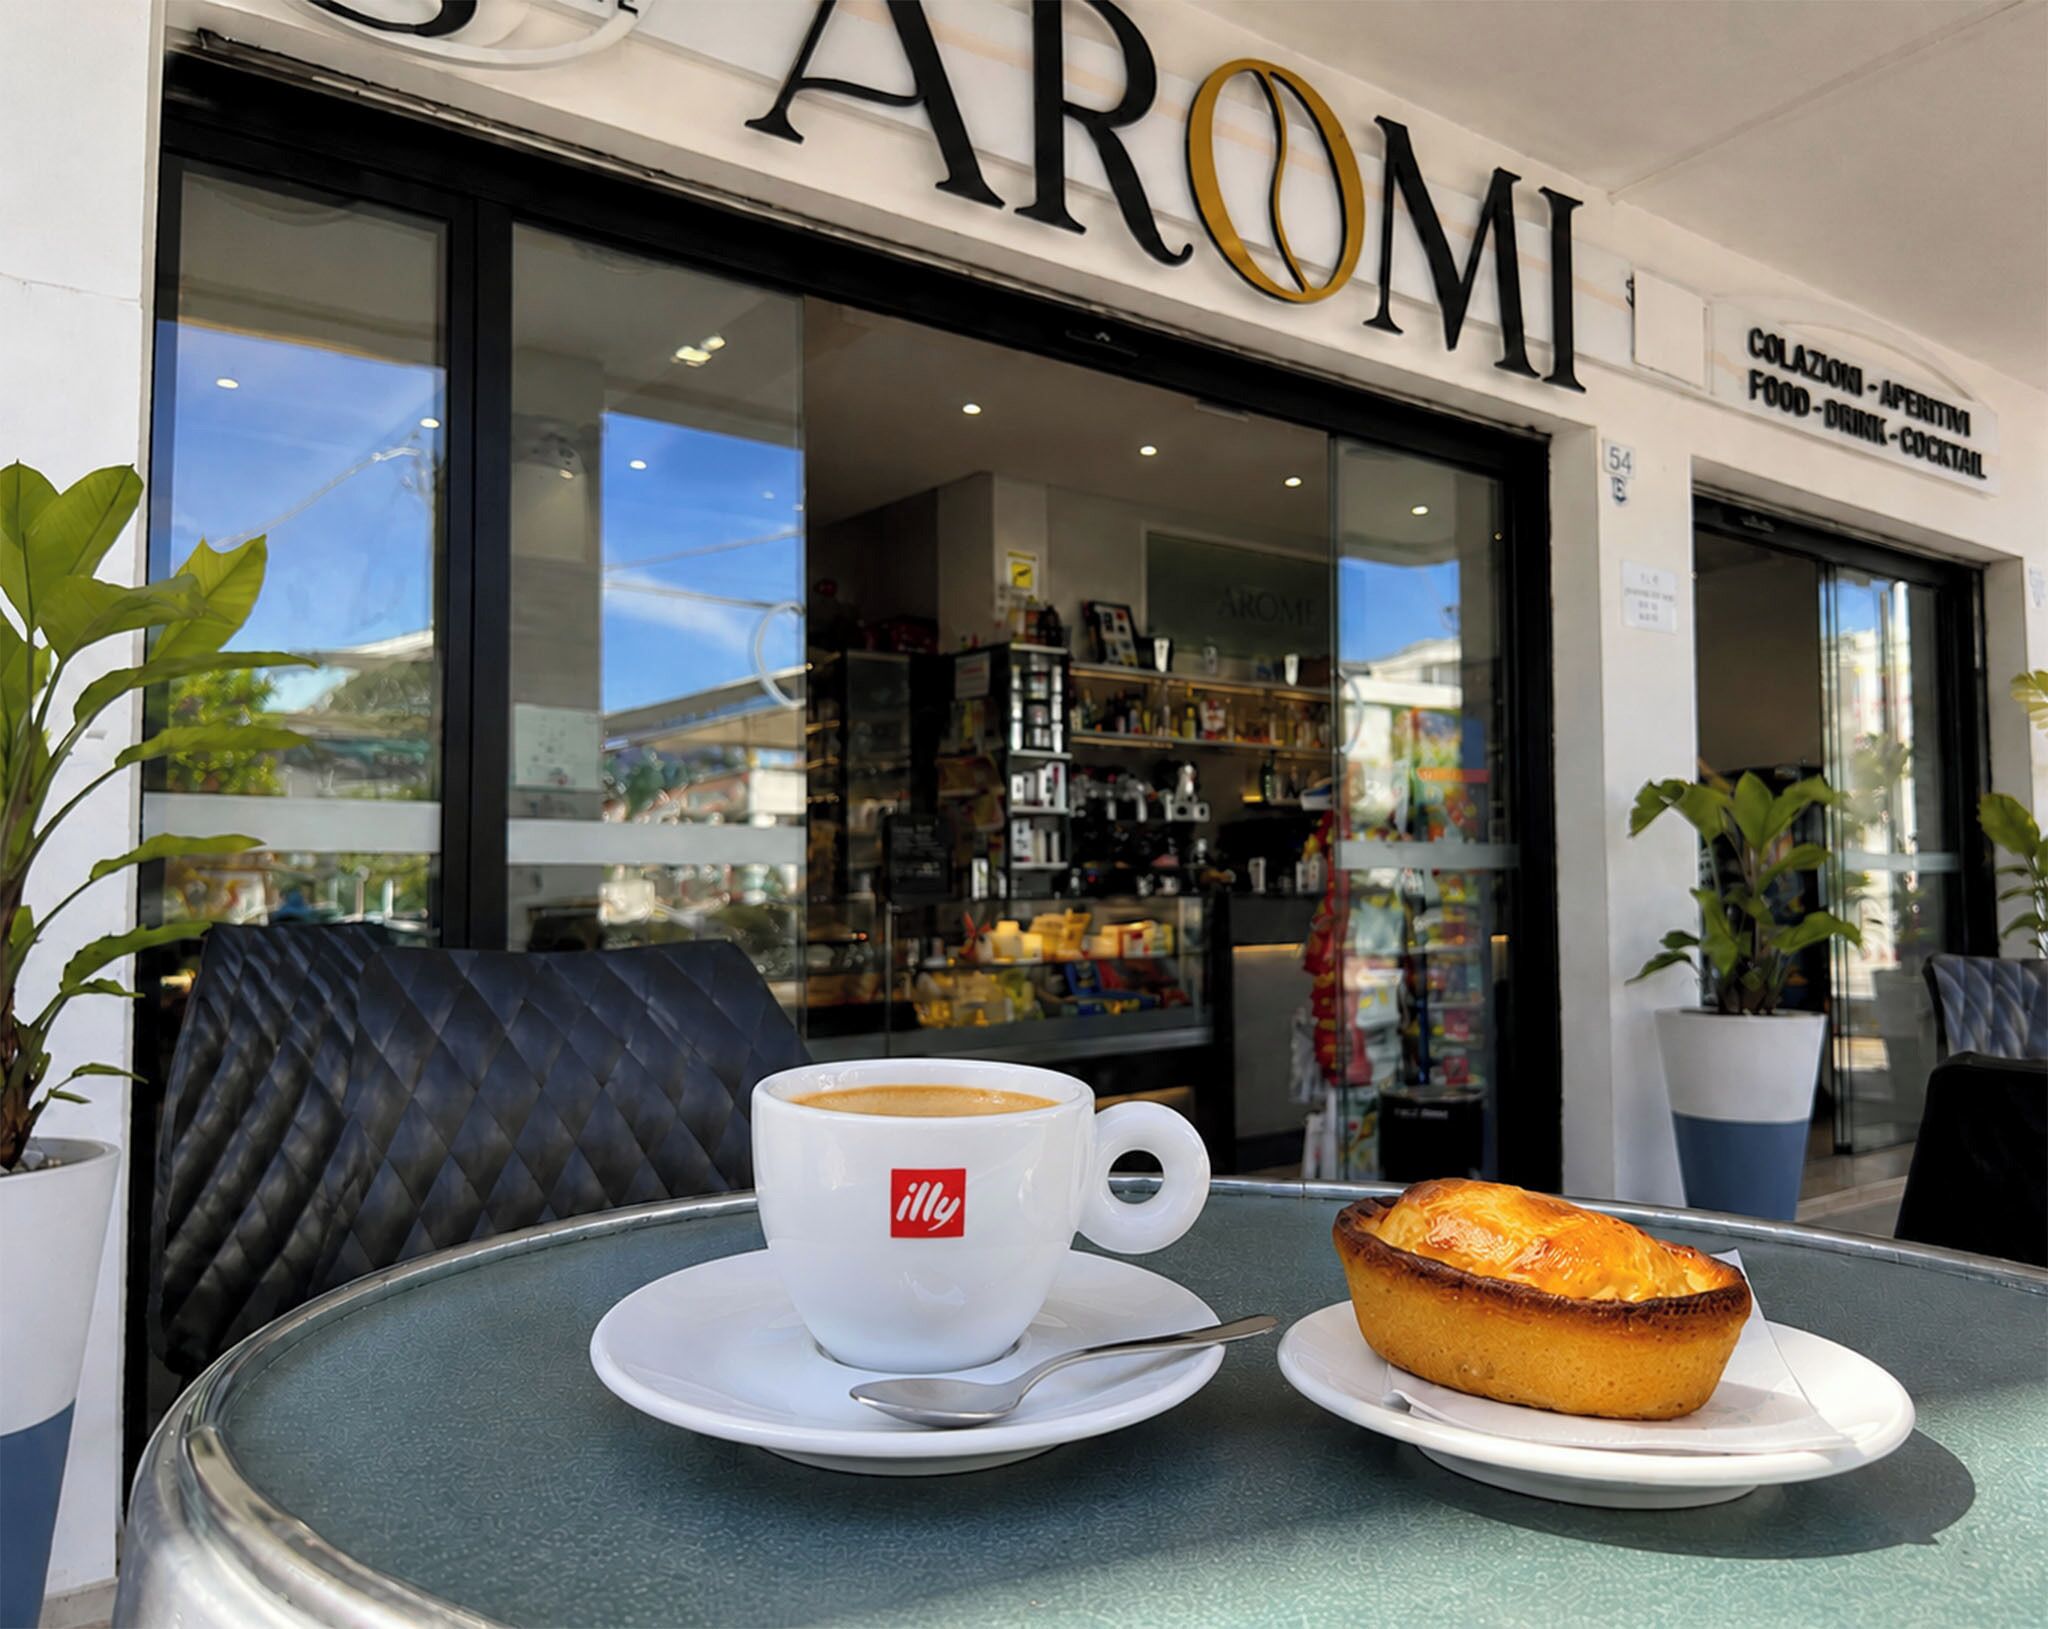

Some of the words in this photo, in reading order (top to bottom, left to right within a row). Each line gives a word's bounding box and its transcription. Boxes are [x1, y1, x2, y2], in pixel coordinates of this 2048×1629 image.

[746, 0, 1587, 394] AROMI
[1748, 328, 1863, 397] COLAZIONI
[1879, 379, 1971, 438] APERITIVI
[1748, 369, 1811, 417] FOOD
[1823, 399, 1889, 446] DRINK
[1899, 427, 1986, 479] COCKTAIL
[1609, 446, 1632, 474] 54
[896, 1181, 961, 1232] illy
